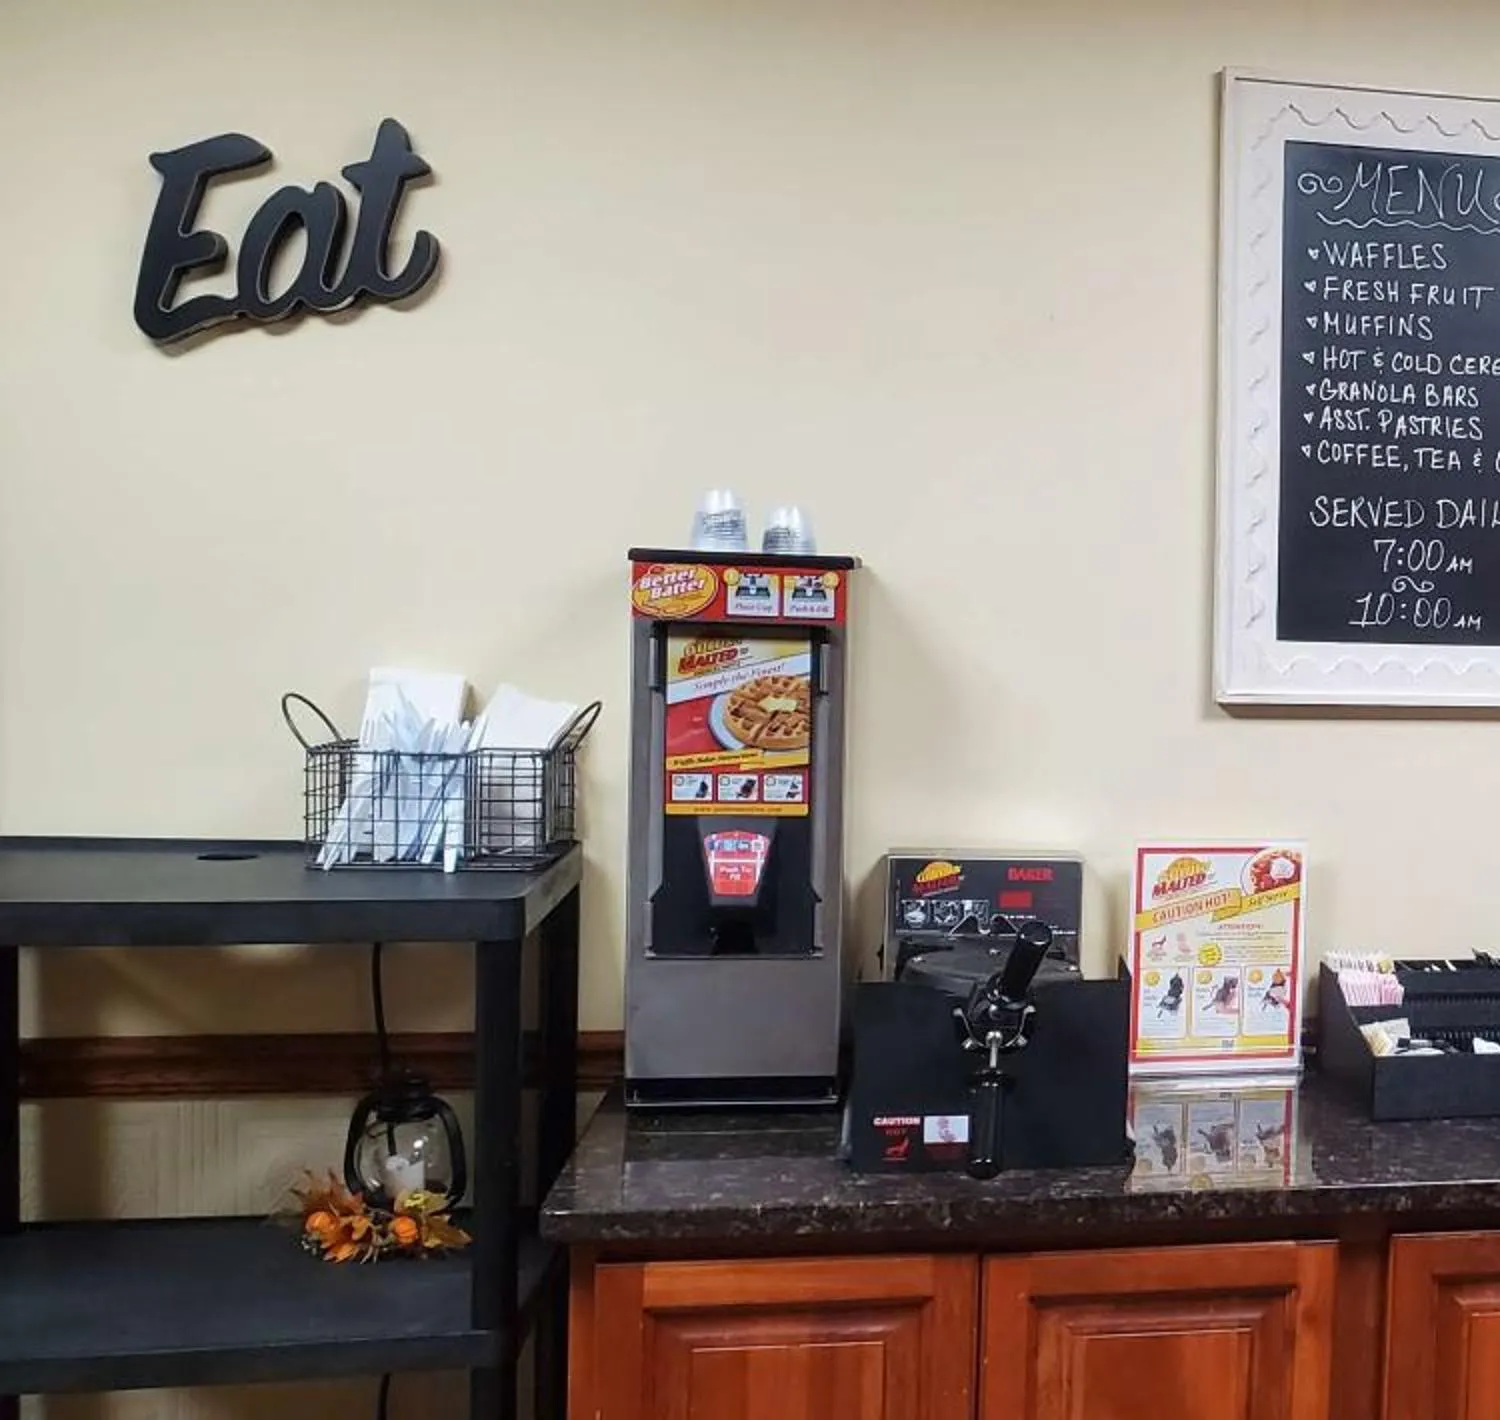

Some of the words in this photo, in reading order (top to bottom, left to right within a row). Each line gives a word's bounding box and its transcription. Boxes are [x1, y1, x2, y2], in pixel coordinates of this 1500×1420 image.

[1334, 162, 1500, 224] MENU
[134, 117, 440, 342] Eat
[1324, 243, 1448, 269] WAFFLES
[1324, 277, 1399, 302] FRESH
[1410, 283, 1494, 309] FRUIT
[1323, 313, 1433, 340] MUFFINS
[1323, 348, 1365, 370] HOT
[1392, 352, 1441, 374] COLD
[1320, 378, 1415, 404] GRANOLA
[1426, 384, 1479, 407] BARS
[1319, 411, 1370, 432] ASST.
[1379, 411, 1483, 440] PASTRIES
[1317, 445, 1409, 472] COFFEE,
[1414, 449, 1461, 471] TEA
[1310, 496, 1425, 529] SERVED
[1374, 539, 1444, 573] 7:00
[1446, 556, 1473, 573] AM
[1348, 593, 1451, 628] 10:00
[1453, 614, 1482, 629] AM
[1152, 902, 1203, 923] CAUTION
[873, 1116, 920, 1127] CAUTION
